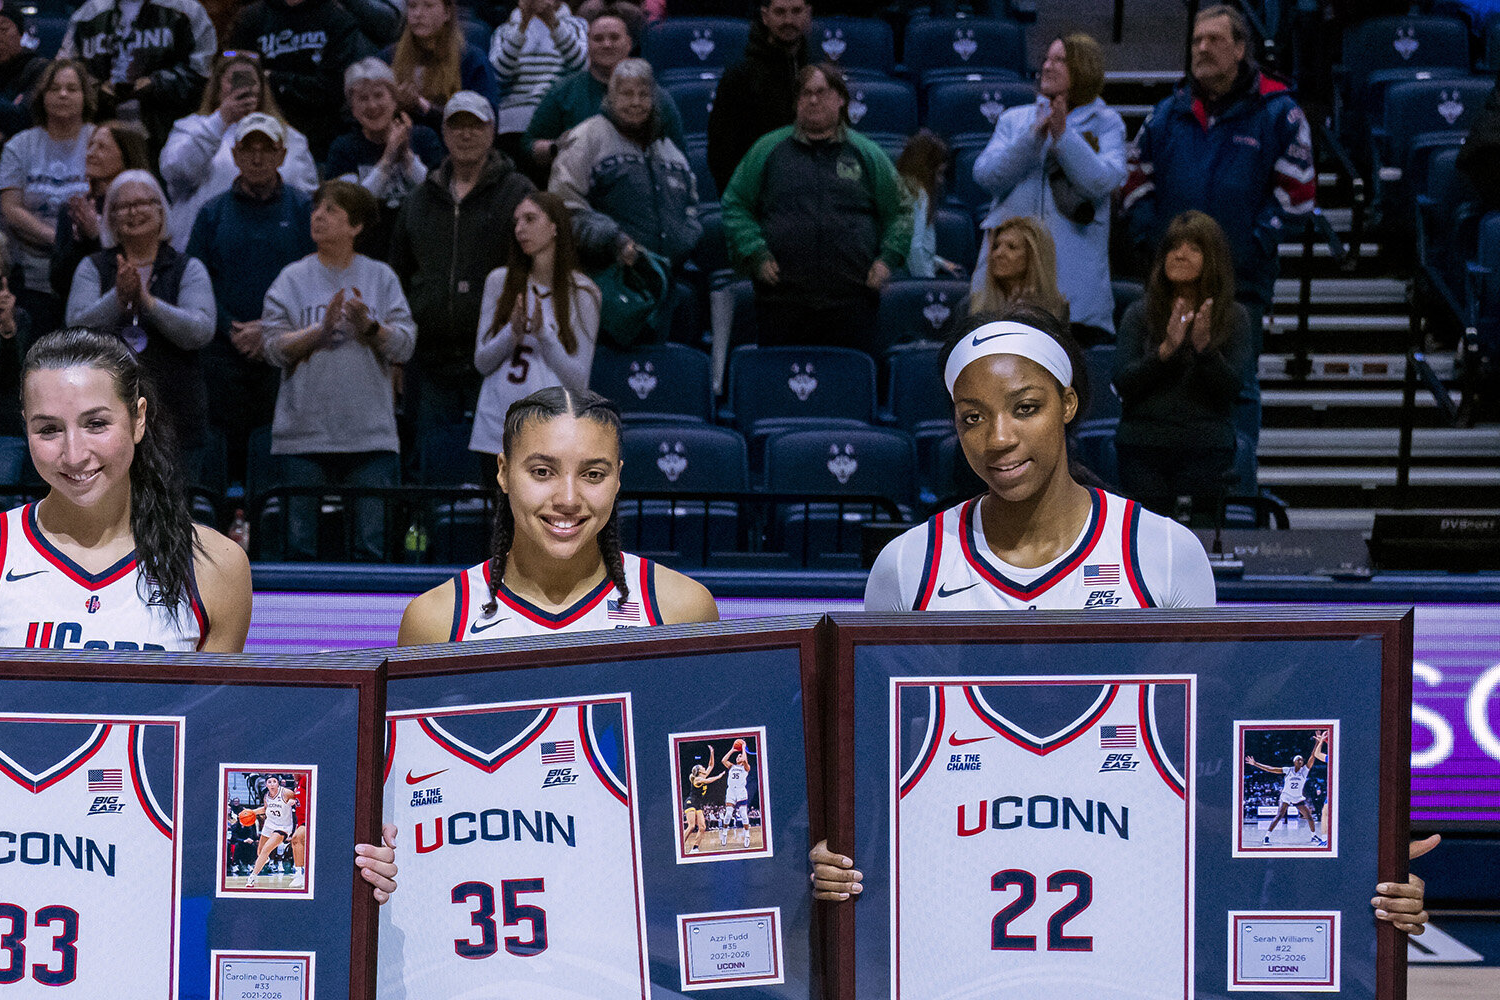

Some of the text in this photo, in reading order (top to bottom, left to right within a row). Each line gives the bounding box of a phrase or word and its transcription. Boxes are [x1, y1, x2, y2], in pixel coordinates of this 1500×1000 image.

[507, 345, 534, 384] 5
[1089, 590, 1116, 599] BIG
[1085, 597, 1122, 606] EAST
[950, 754, 980, 763] BE THE
[1106, 753, 1132, 762] BIG
[947, 762, 982, 771] CHANGE
[1102, 761, 1140, 769] EAST
[548, 768, 573, 777] BIG
[544, 774, 580, 784] EAST
[413, 787, 441, 799] BE THE
[93, 796, 119, 804] BIG
[410, 796, 443, 807] CHANGE
[88, 803, 126, 812] EAST
[957, 795, 1129, 840] UCONN
[415, 808, 576, 854] UCONN
[991, 868, 1093, 952] 22
[451, 877, 548, 960] 35
[710, 933, 748, 943] Azzi Fudd
[1253, 935, 1314, 943] Serah Williams
[710, 951, 750, 960] 2021-2026
[1260, 954, 1306, 962] 2025-2026
[717, 961, 745, 970] UCONN
[1268, 965, 1299, 973] UCONN
[225, 973, 299, 981] Caroline Ducharme
[241, 992, 282, 1000] 2021-2026
